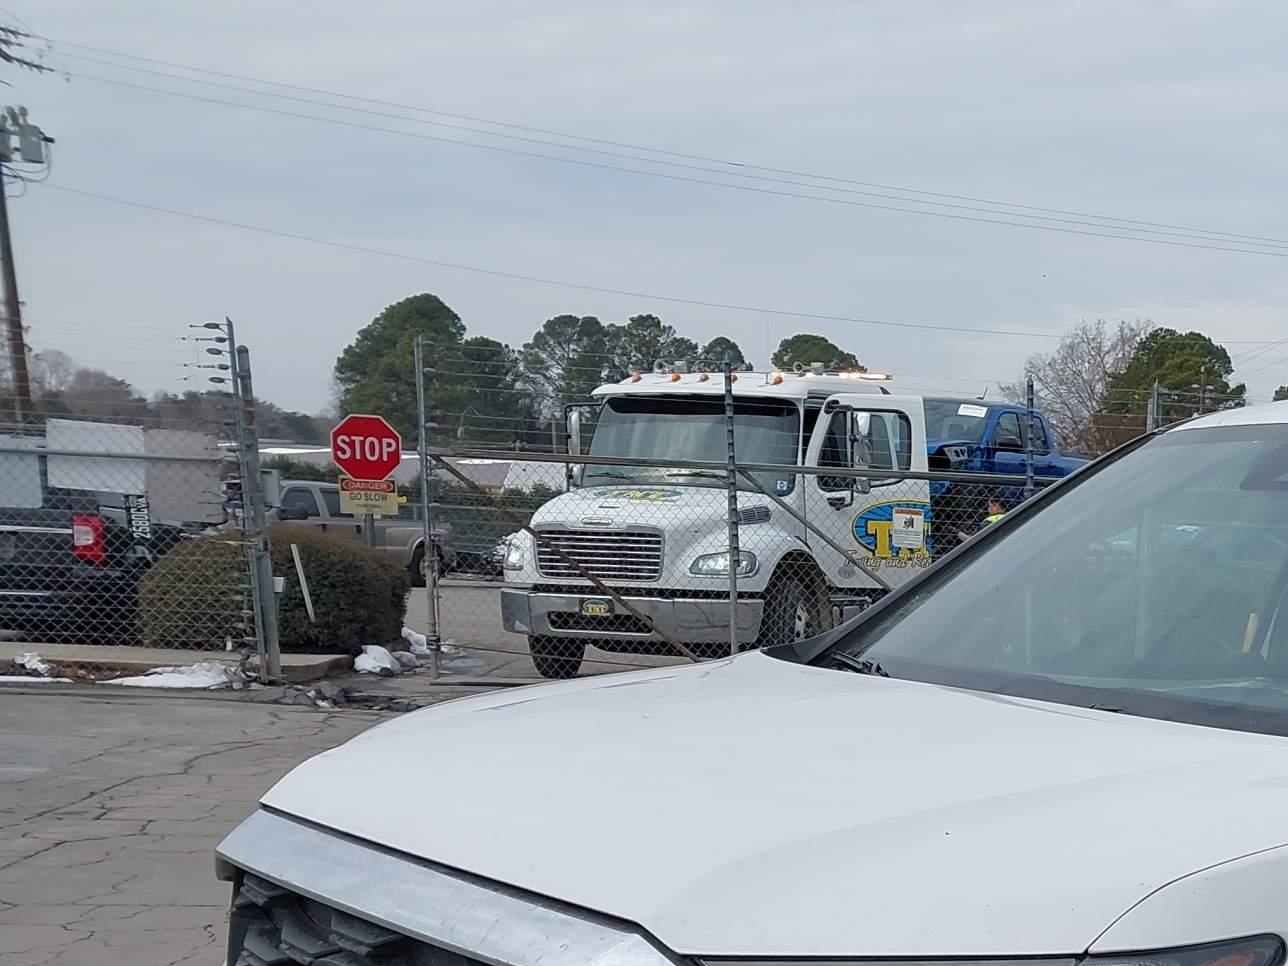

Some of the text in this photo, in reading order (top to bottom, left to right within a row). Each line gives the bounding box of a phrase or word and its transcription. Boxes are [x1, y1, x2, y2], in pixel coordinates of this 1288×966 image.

[336, 435, 397, 462] STOP
[349, 492, 388, 502] GO SLOW
[885, 553, 908, 568] and
